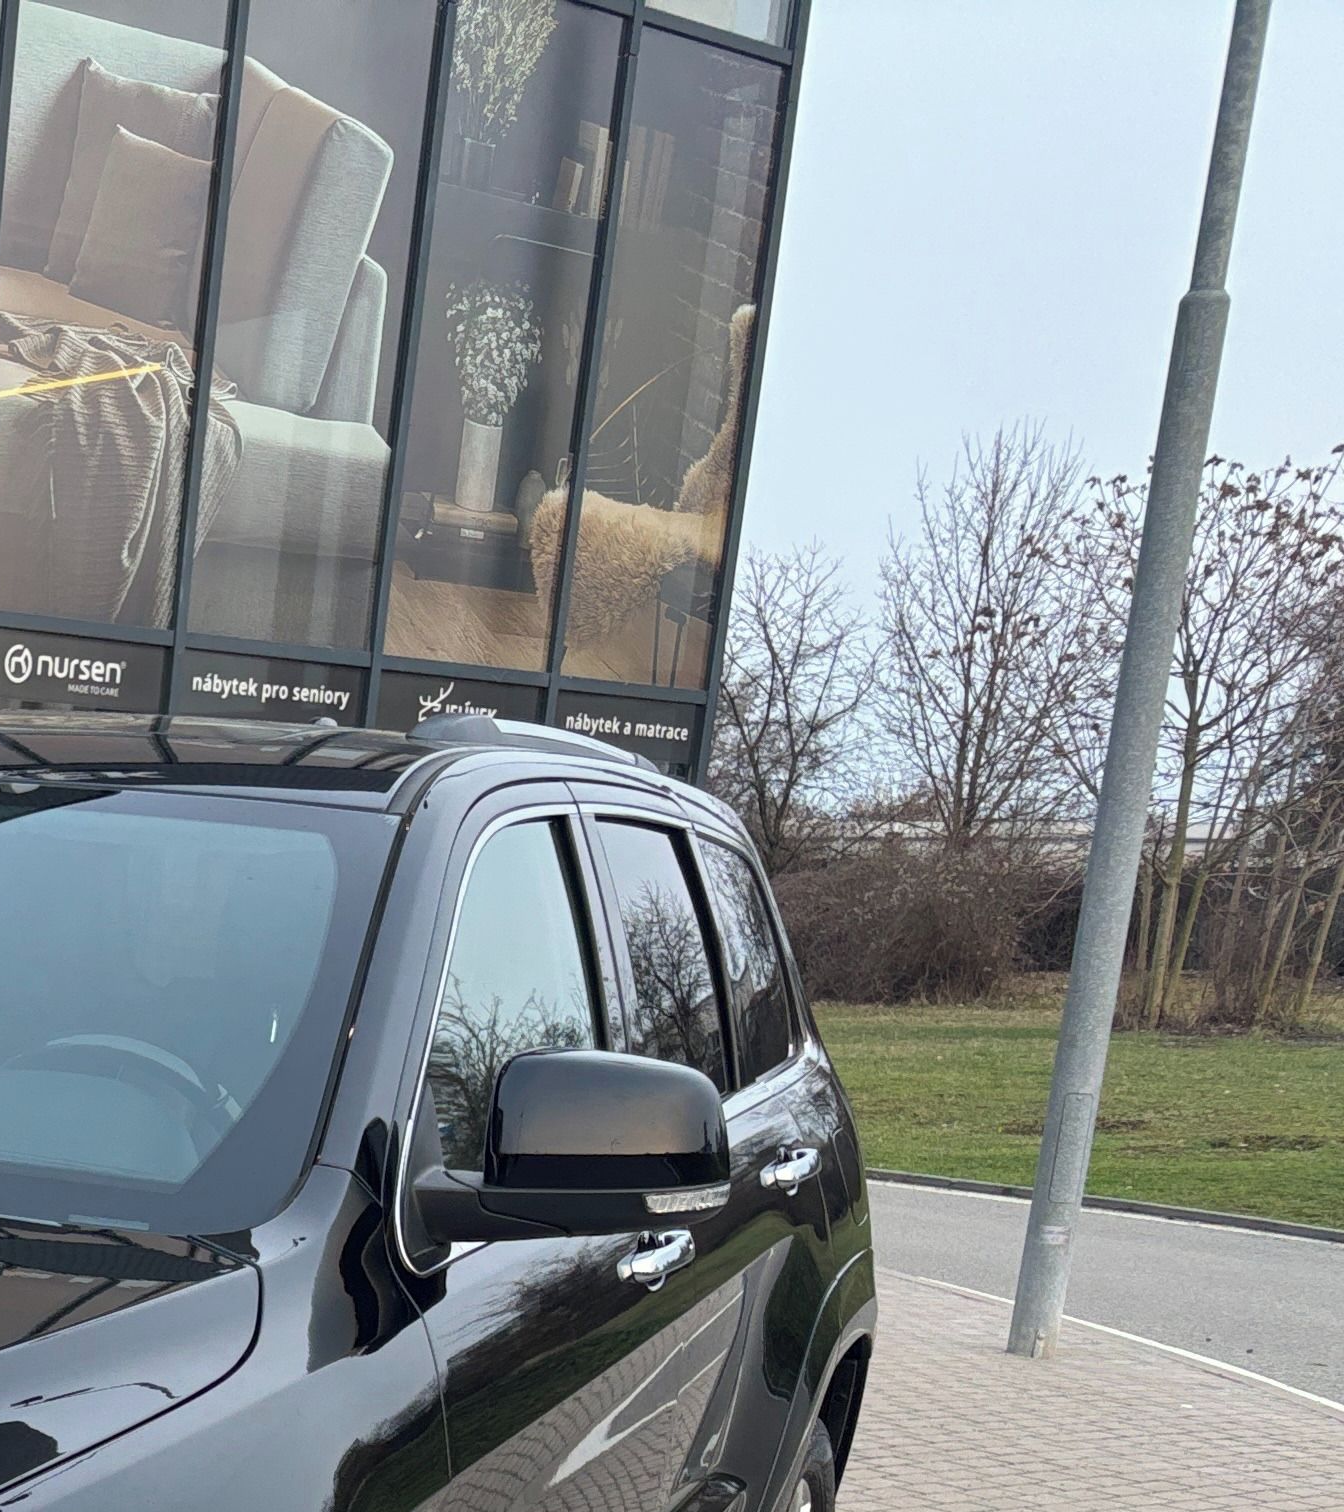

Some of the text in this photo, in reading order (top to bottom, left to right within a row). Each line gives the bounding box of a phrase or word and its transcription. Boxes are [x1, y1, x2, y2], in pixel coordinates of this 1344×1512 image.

[67, 683, 90, 695] MADE
[191, 673, 351, 711] nábytek pro seniory
[565, 712, 689, 741] nábytek a matrace
